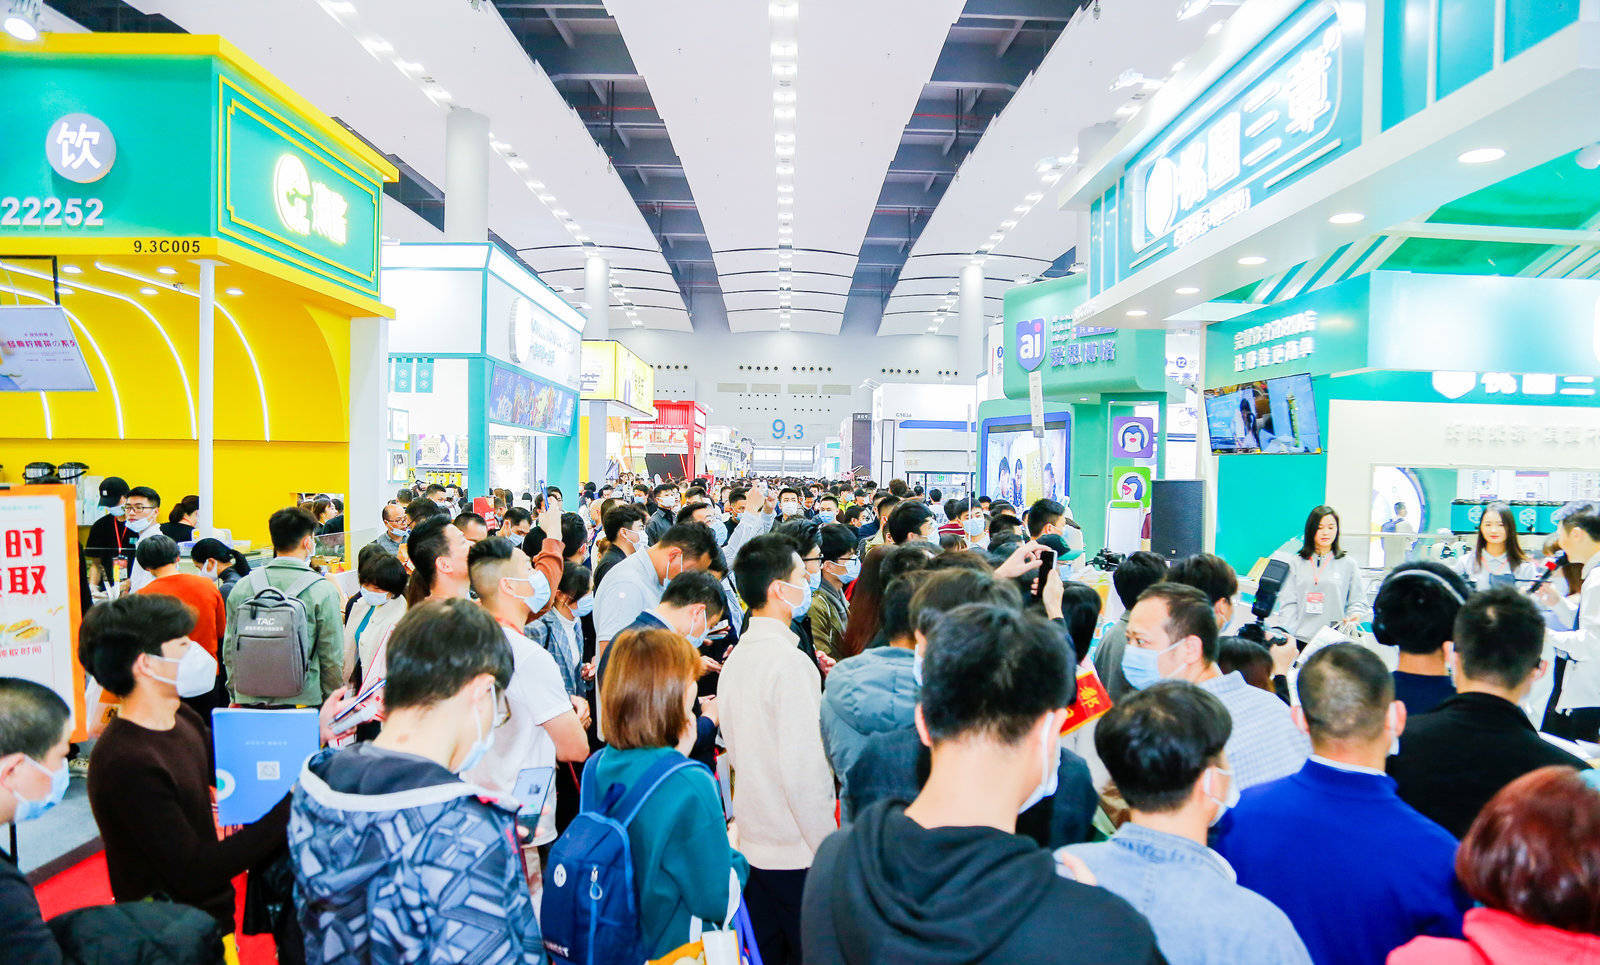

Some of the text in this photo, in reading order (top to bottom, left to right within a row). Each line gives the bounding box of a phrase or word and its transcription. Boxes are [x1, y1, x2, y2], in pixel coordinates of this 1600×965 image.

[56, 122, 102, 170] 饮
[1, 197, 104, 226] 22252
[133, 240, 201, 253] 9.3C005
[1020, 322, 1042, 359] ai
[772, 418, 804, 439] 9.3
[5, 527, 45, 558] 时
[0, 565, 47, 595] 取
[256, 617, 276, 626] TAC
